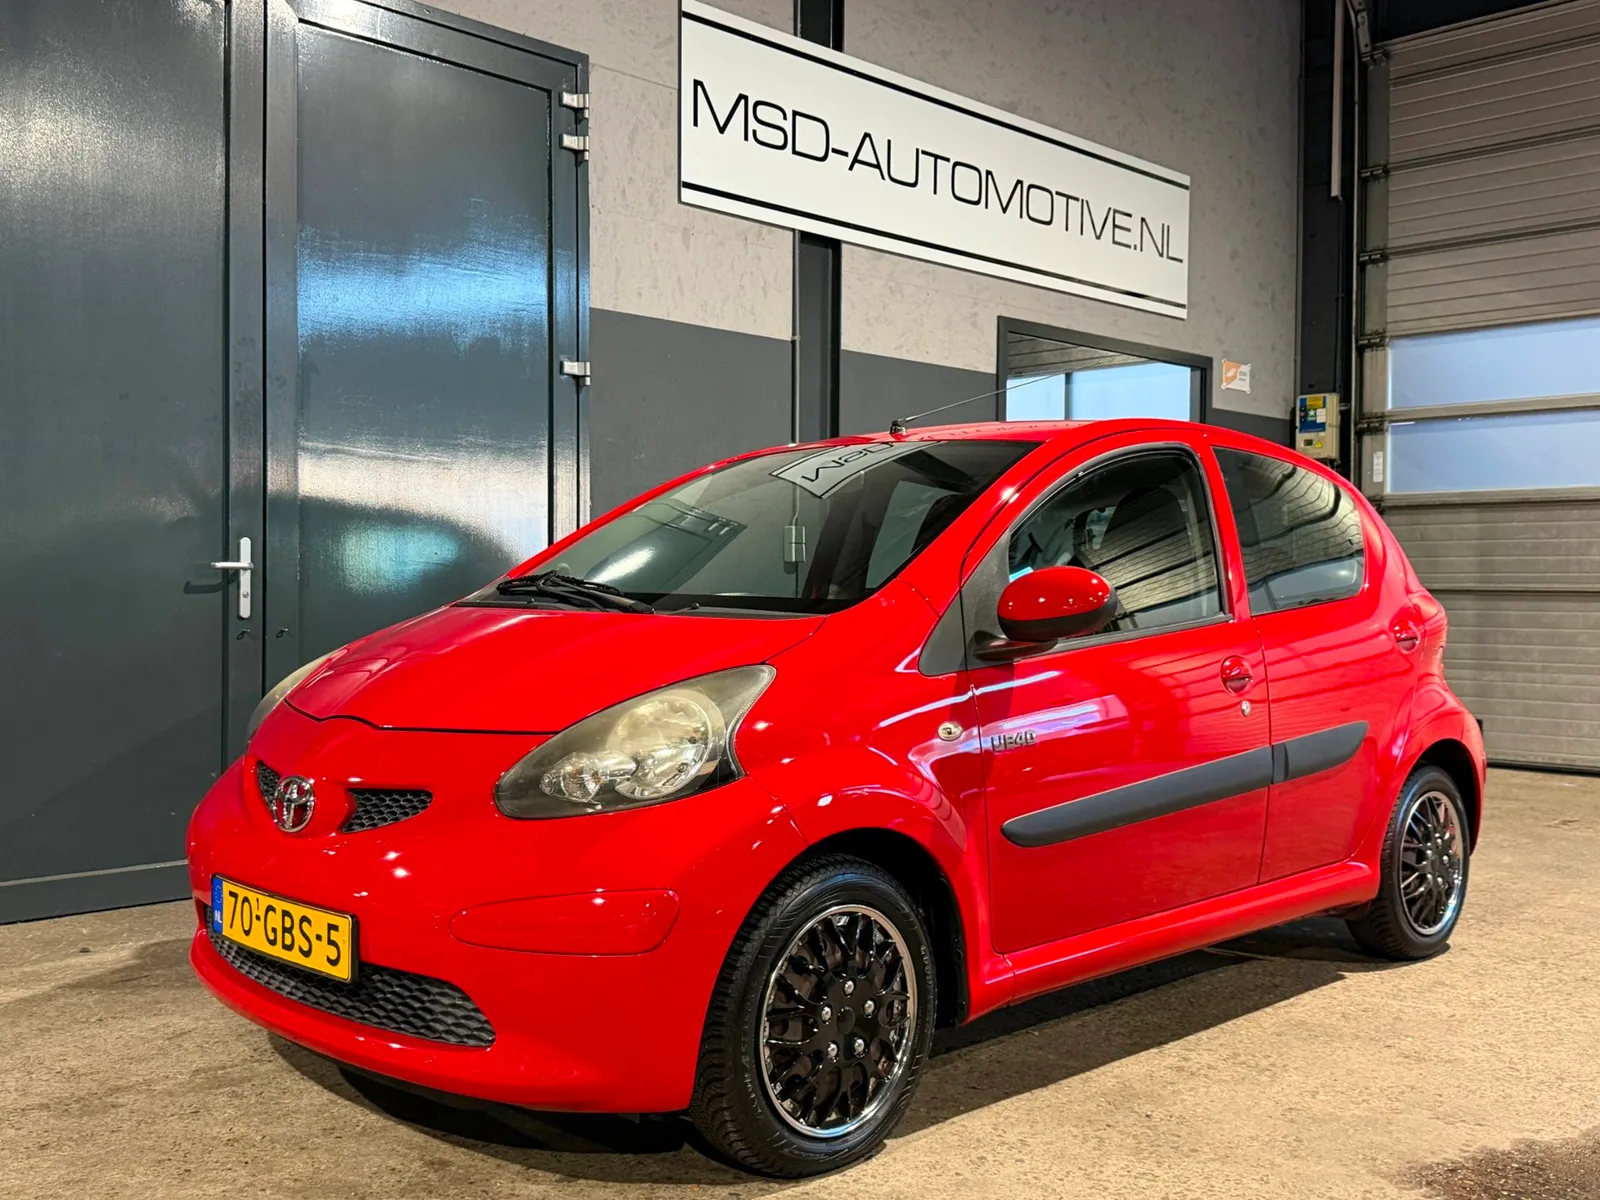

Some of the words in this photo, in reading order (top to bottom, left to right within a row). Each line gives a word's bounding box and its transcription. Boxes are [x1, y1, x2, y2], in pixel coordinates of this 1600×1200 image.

[692, 78, 1184, 263] MSD-AUTOMOTIVE.NL
[214, 909, 222, 923] NL
[228, 891, 341, 967] 70-GBS-5
